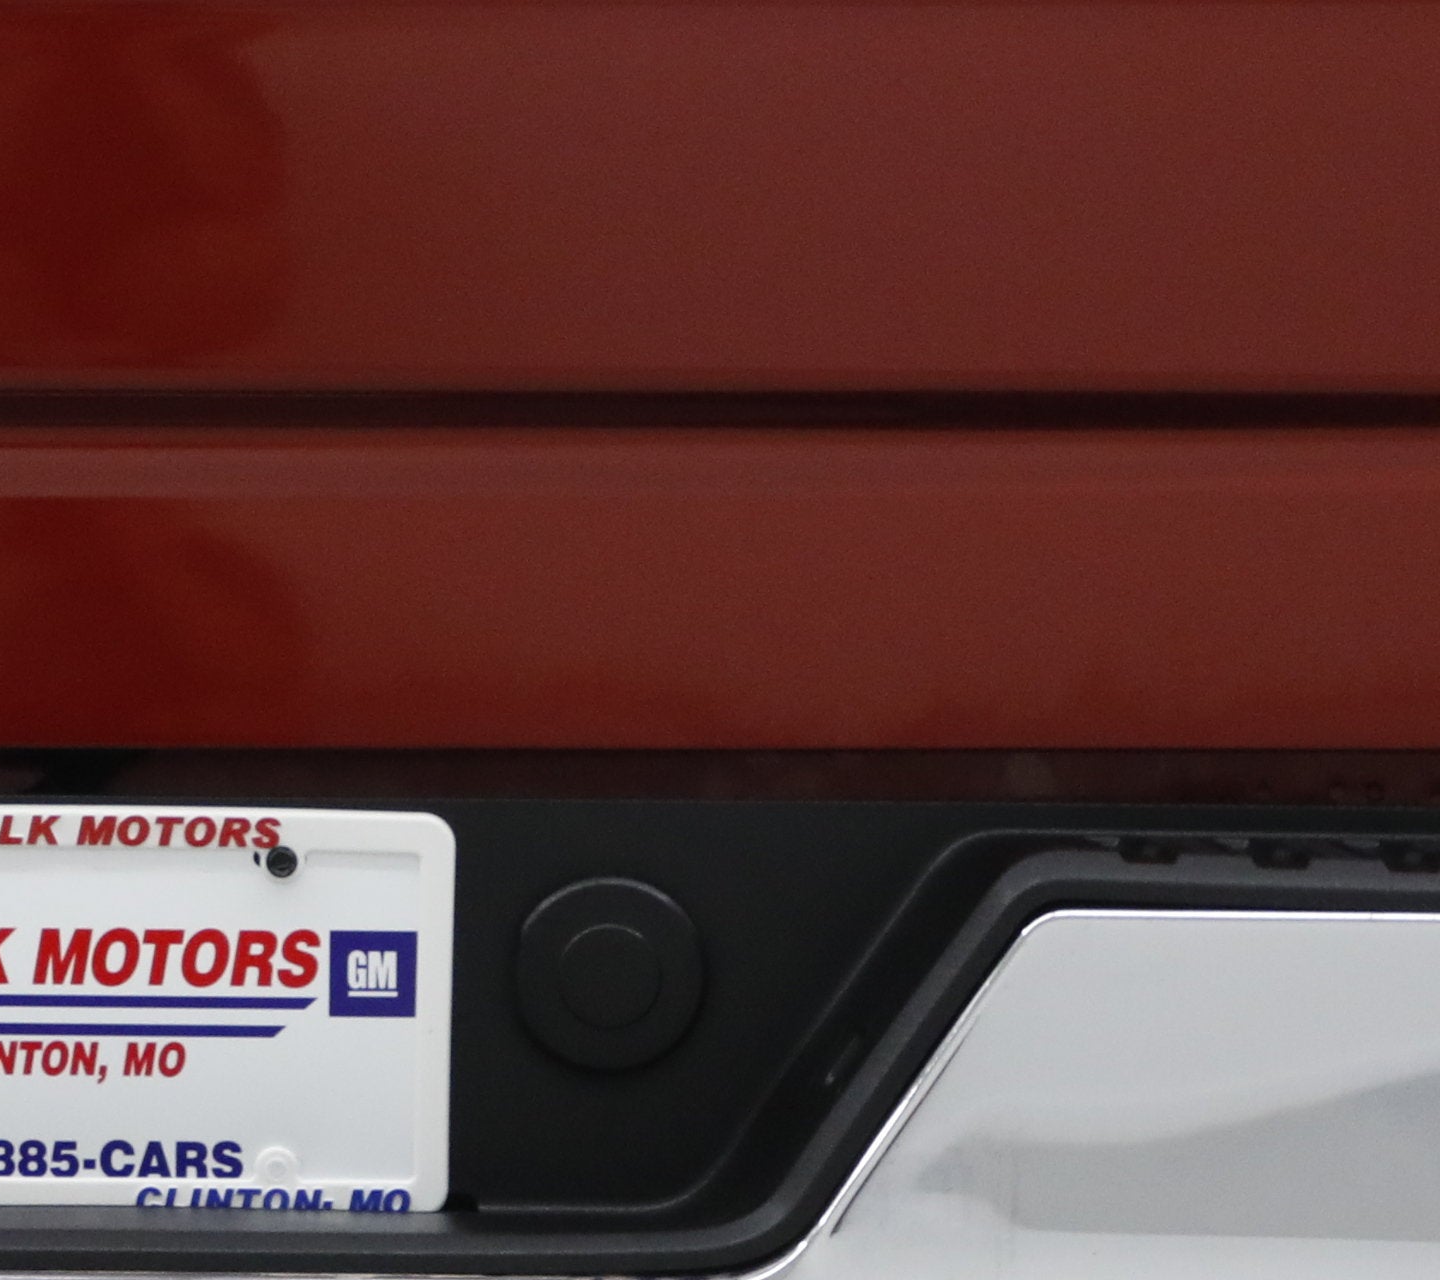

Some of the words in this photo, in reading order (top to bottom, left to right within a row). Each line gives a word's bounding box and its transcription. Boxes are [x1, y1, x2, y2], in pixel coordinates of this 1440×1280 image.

[76, 815, 282, 849] MOTORS
[31, 928, 321, 989] MOTORS
[122, 1041, 187, 1078] MO
[348, 1188, 413, 1214] MO
